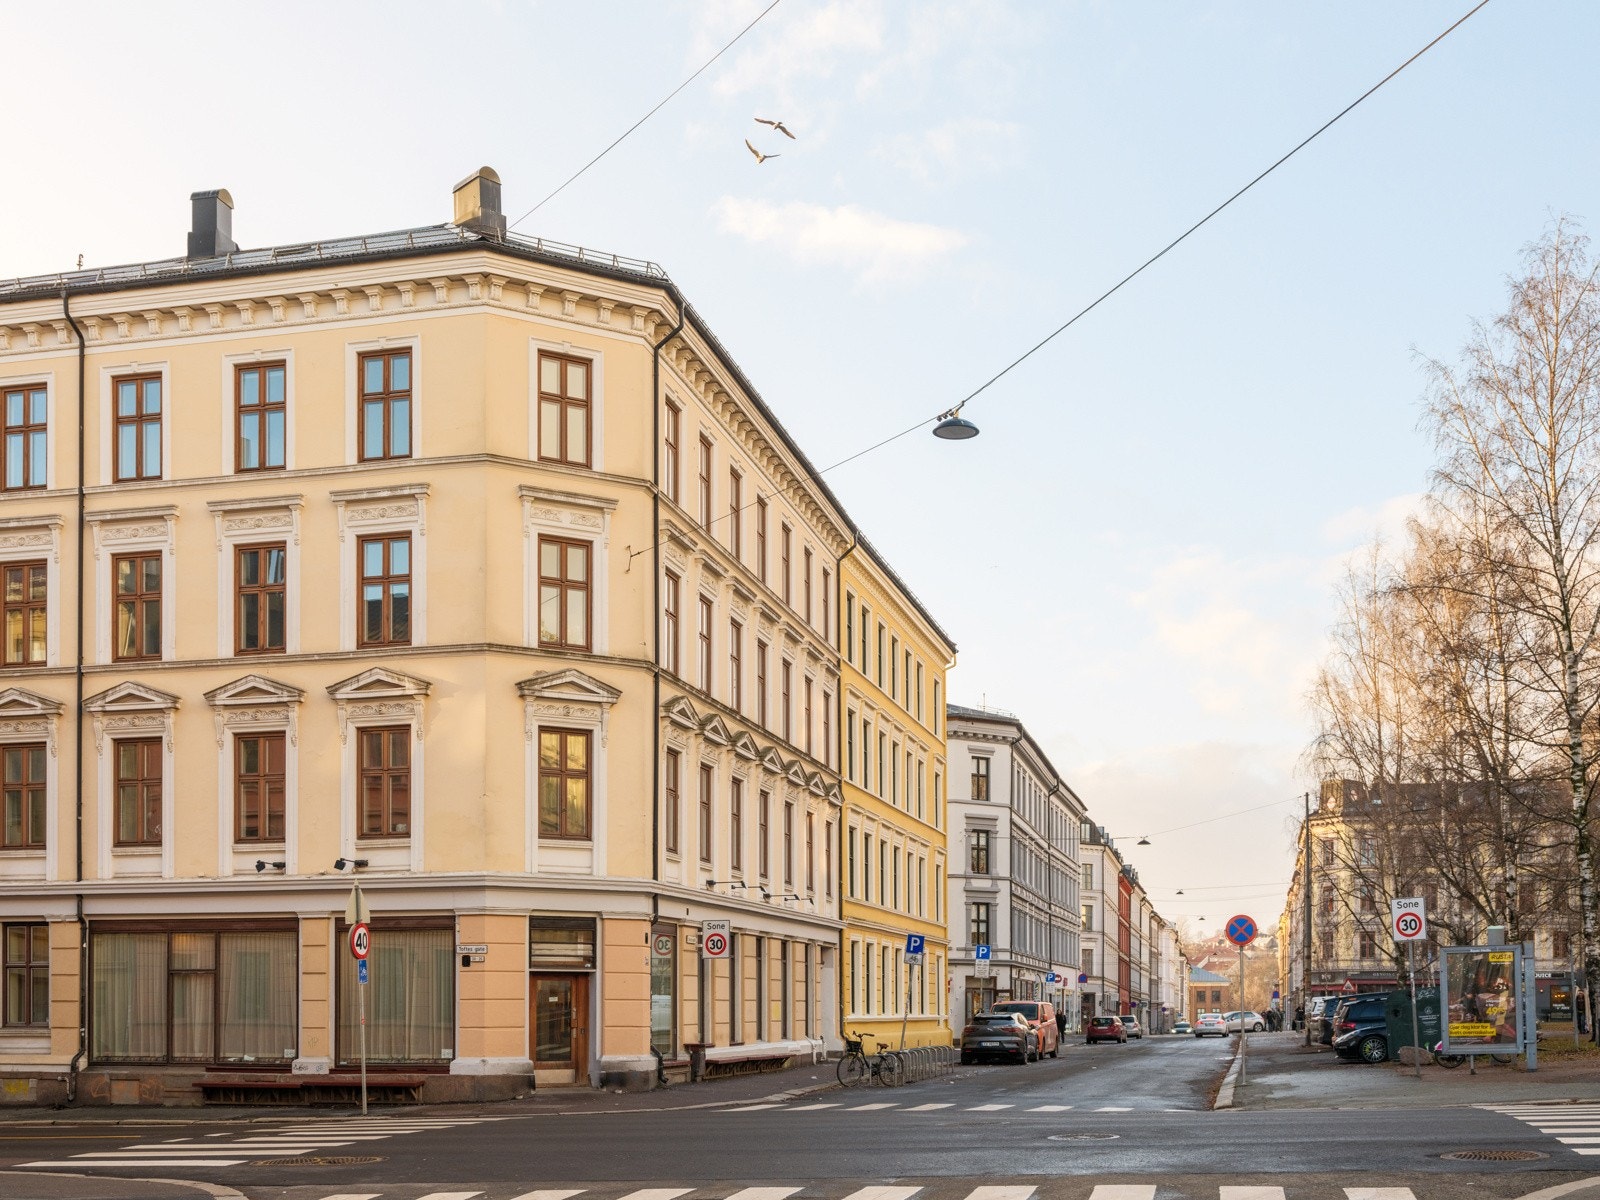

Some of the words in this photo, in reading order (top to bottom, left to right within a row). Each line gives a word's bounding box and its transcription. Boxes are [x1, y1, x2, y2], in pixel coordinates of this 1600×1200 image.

[1396, 901, 1419, 909] Sone
[1401, 919, 1418, 931] 30
[355, 933, 367, 949] 40
[709, 939, 723, 950] 30
[910, 937, 920, 951] P
[979, 947, 987, 957] P
